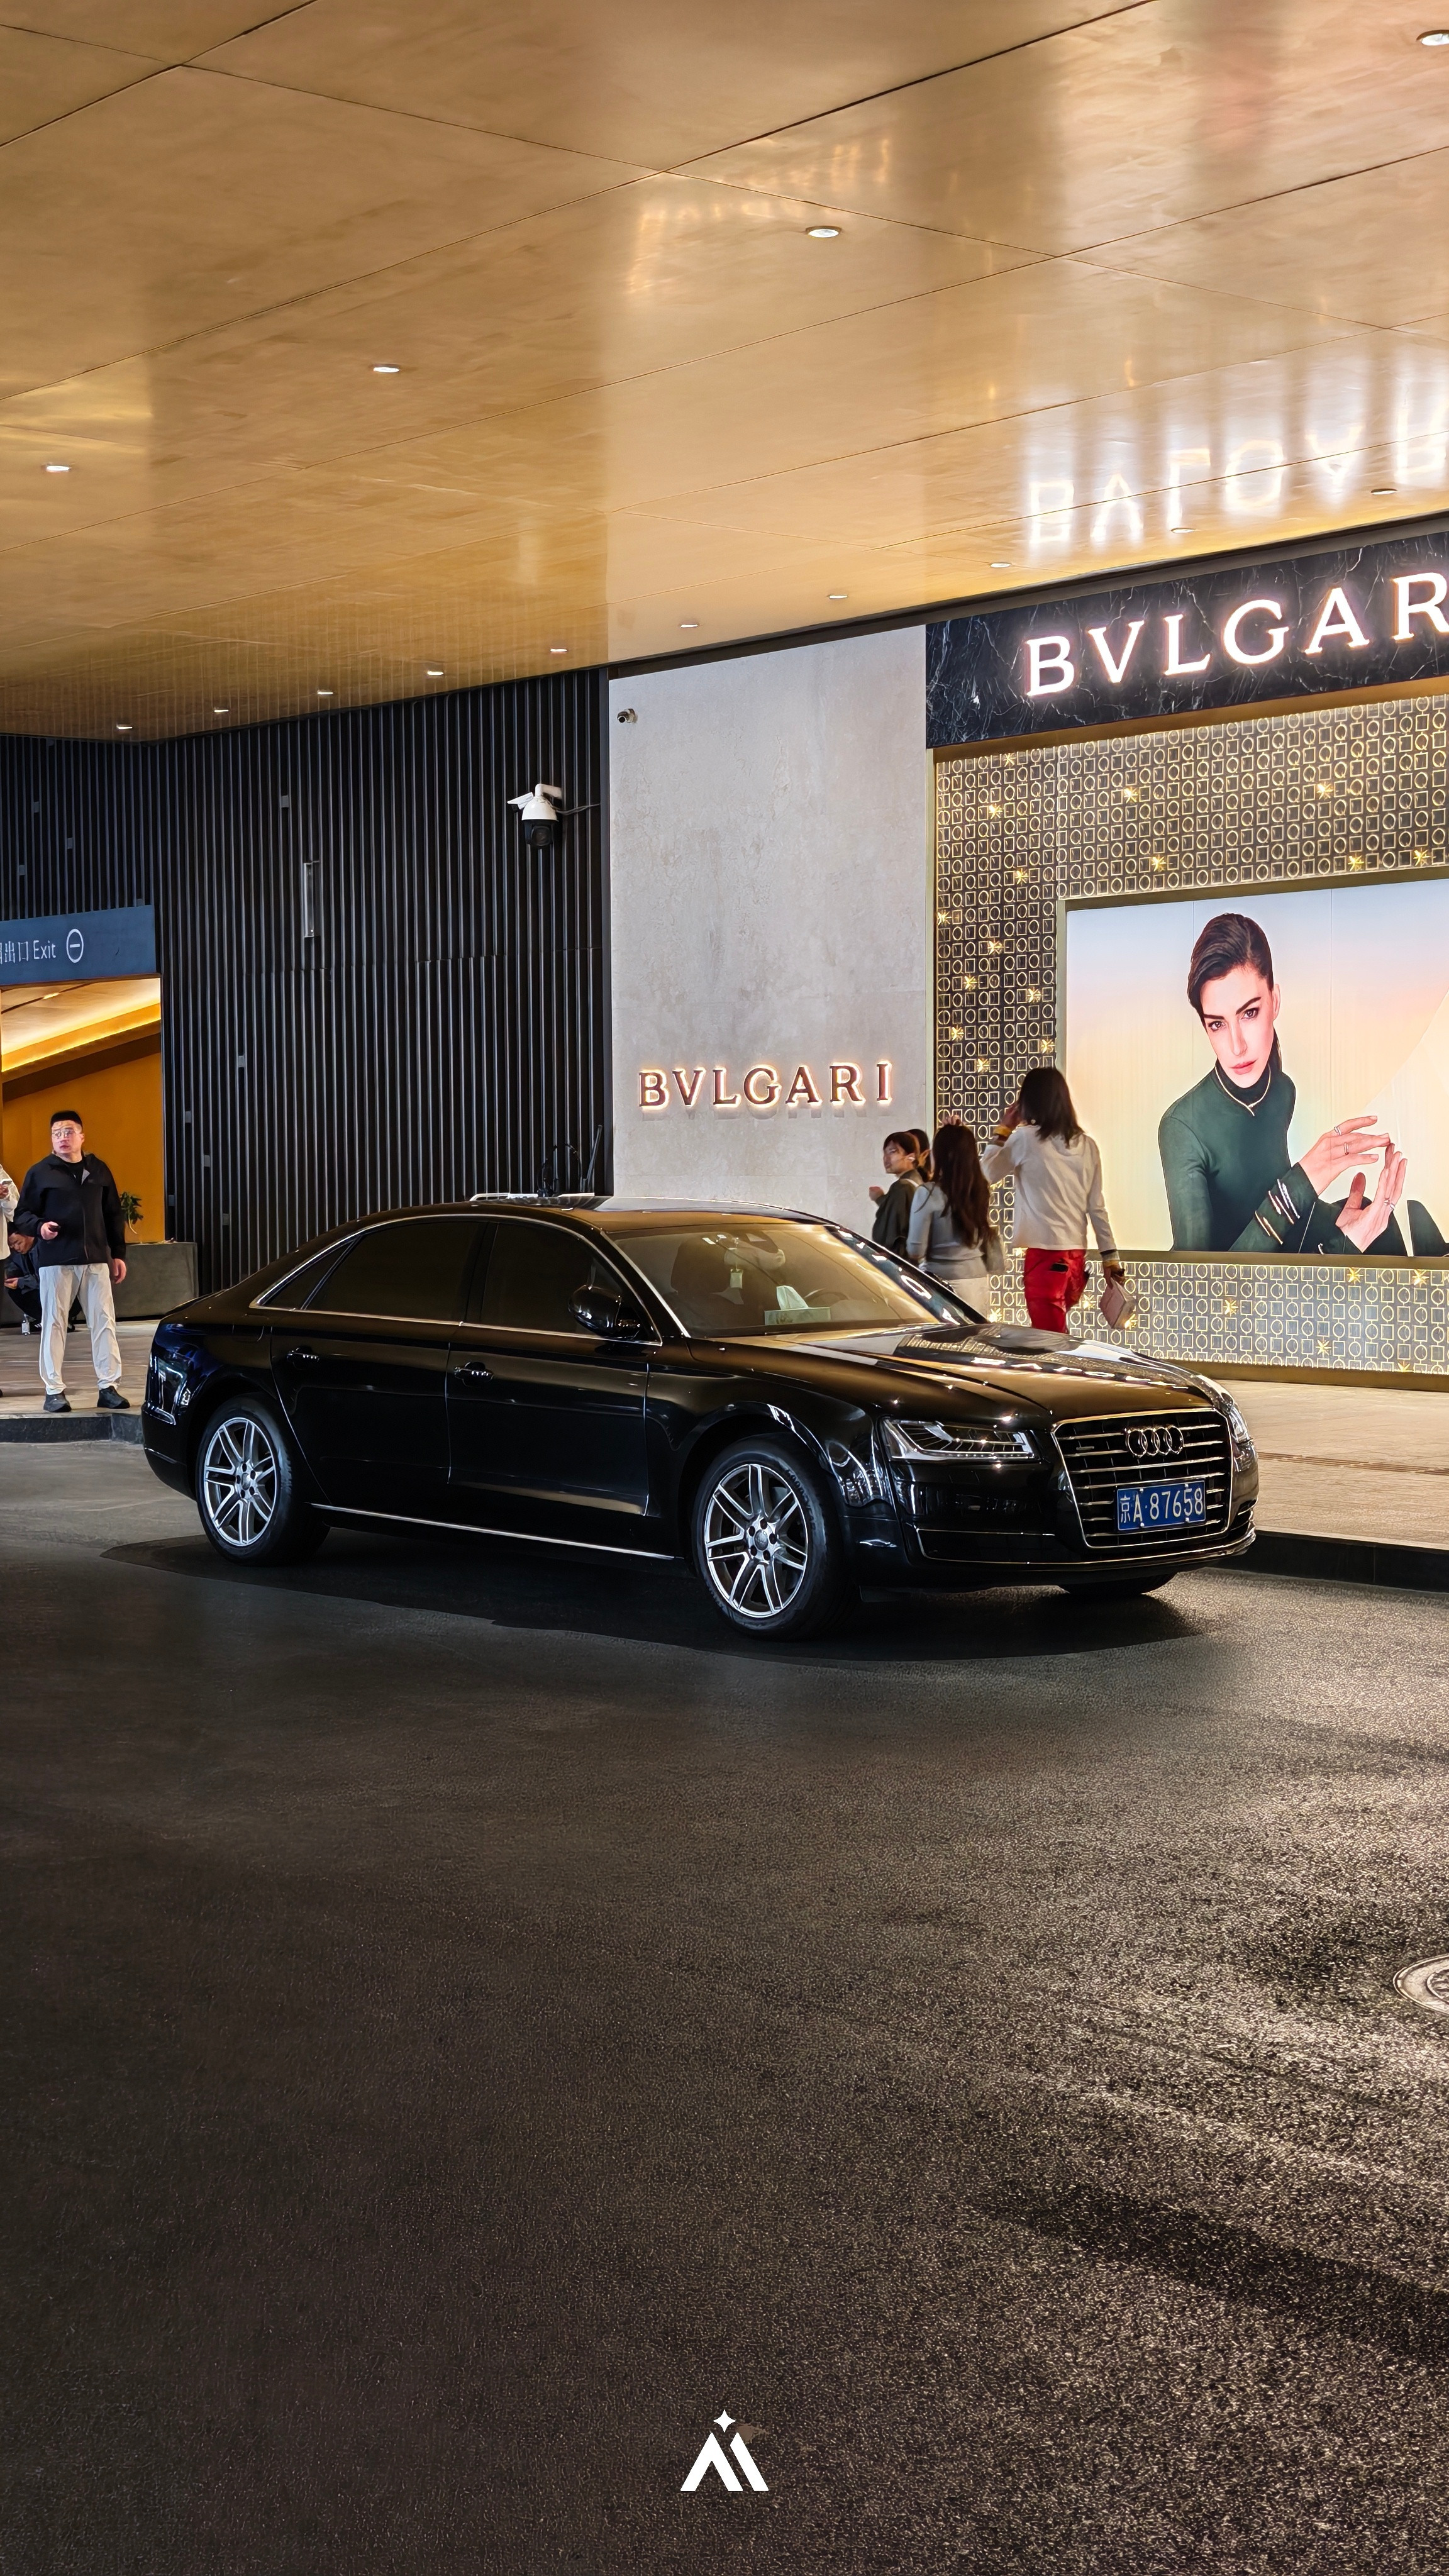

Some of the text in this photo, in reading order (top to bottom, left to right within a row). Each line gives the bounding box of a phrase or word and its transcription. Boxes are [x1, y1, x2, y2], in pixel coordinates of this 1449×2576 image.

[1025, 571, 1449, 696] BVLGAR
[0, 940, 56, 964] 出口 Exit
[638, 1062, 892, 1108] BVLGARI
